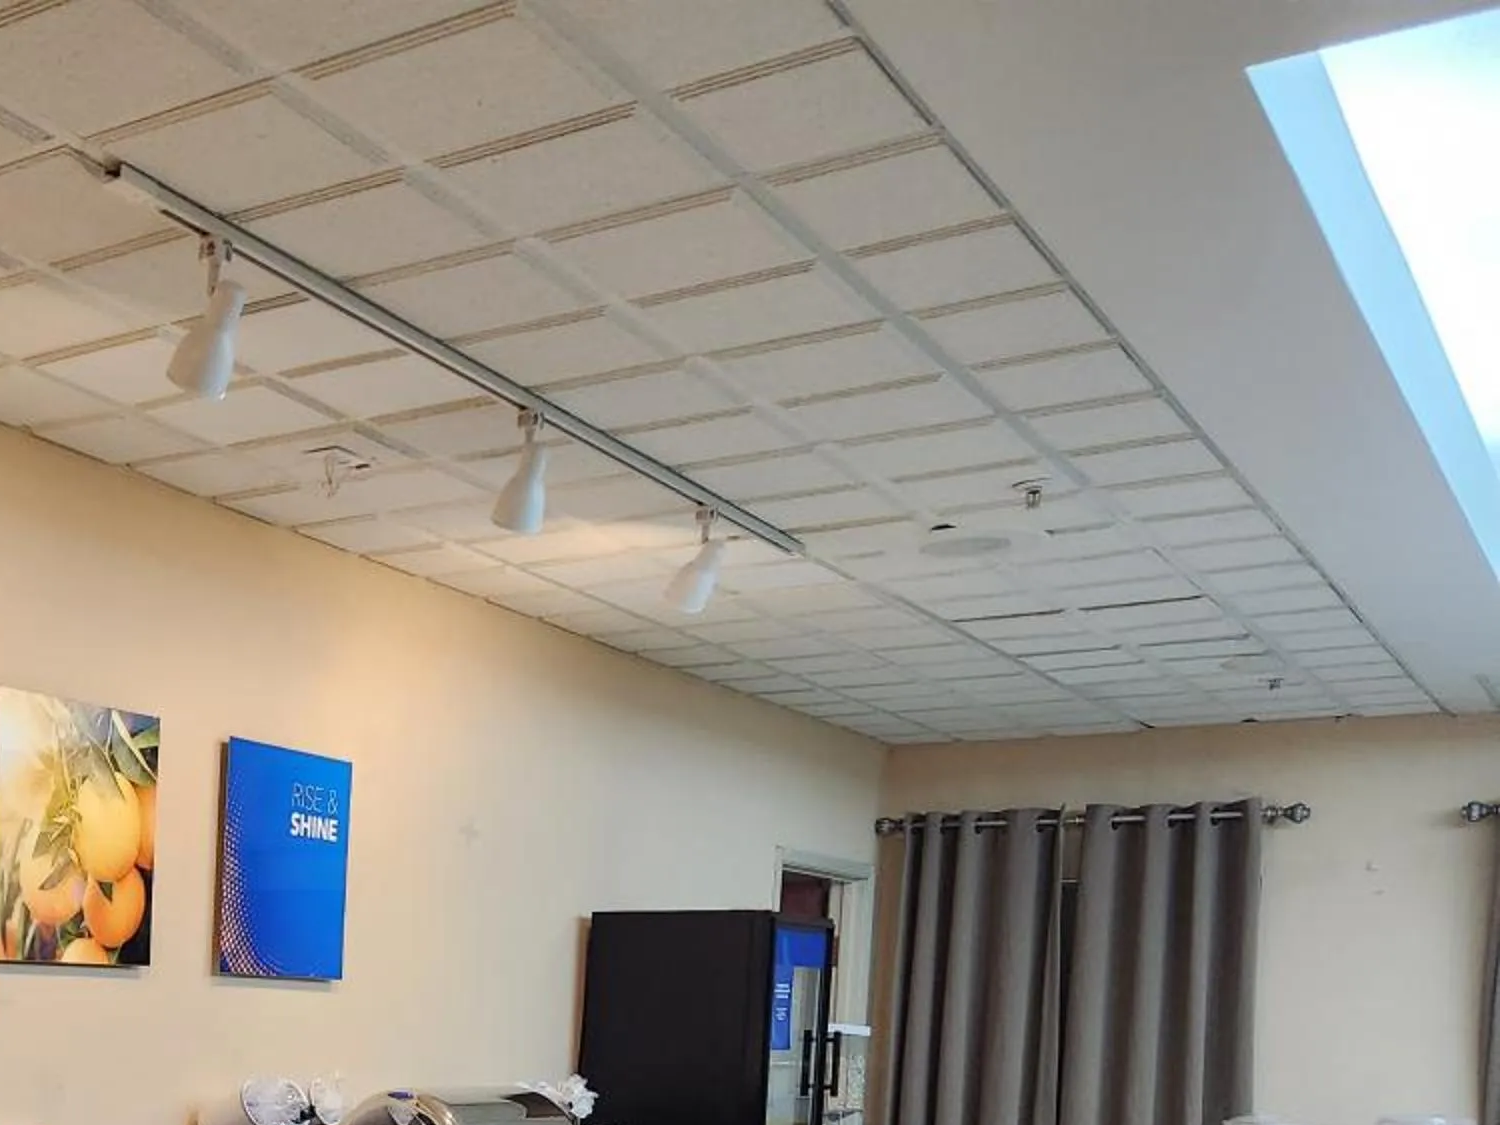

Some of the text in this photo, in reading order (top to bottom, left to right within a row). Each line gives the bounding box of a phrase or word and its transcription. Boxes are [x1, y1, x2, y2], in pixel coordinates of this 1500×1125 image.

[291, 782, 339, 815] RISE &
[290, 811, 339, 843] SHINE
